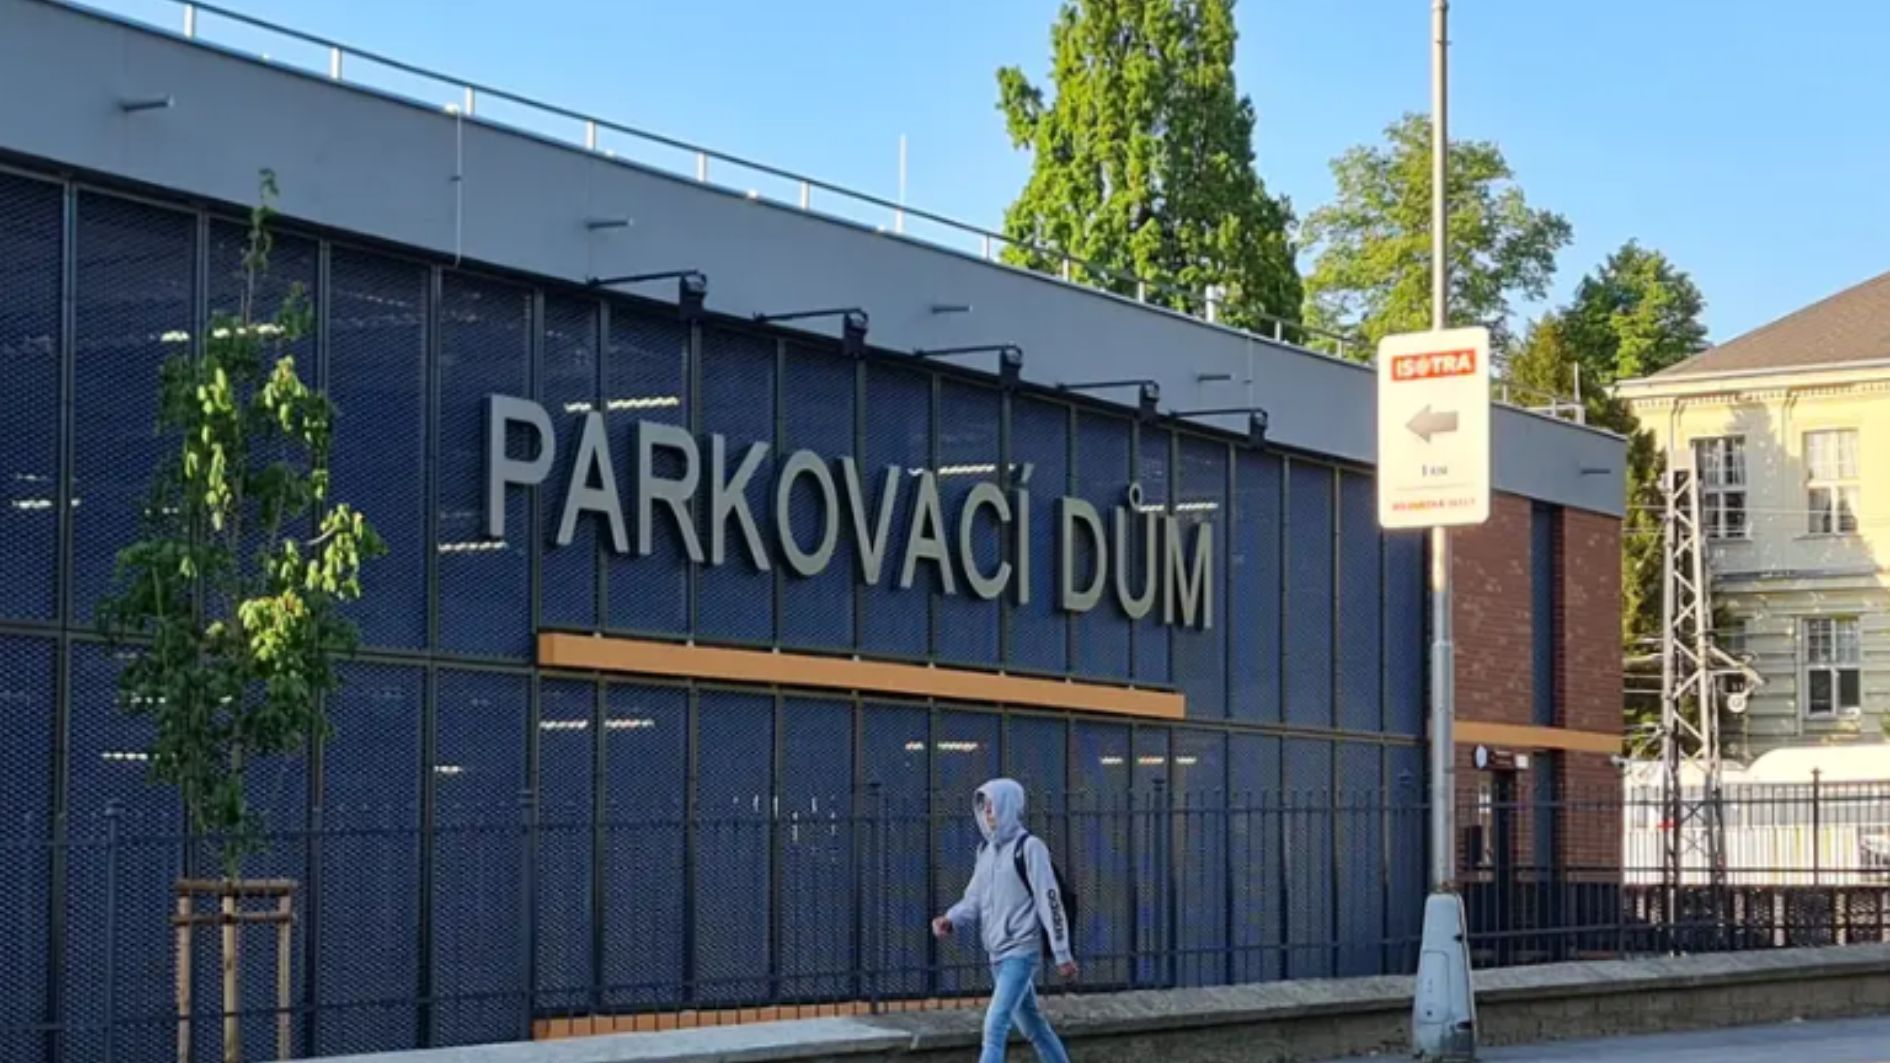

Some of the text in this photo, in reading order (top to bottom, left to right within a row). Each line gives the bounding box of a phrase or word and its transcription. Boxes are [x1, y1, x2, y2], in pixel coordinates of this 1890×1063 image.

[1396, 352, 1471, 379] ISOTRA
[488, 392, 1213, 630] PARKOVACÍ DŮM
